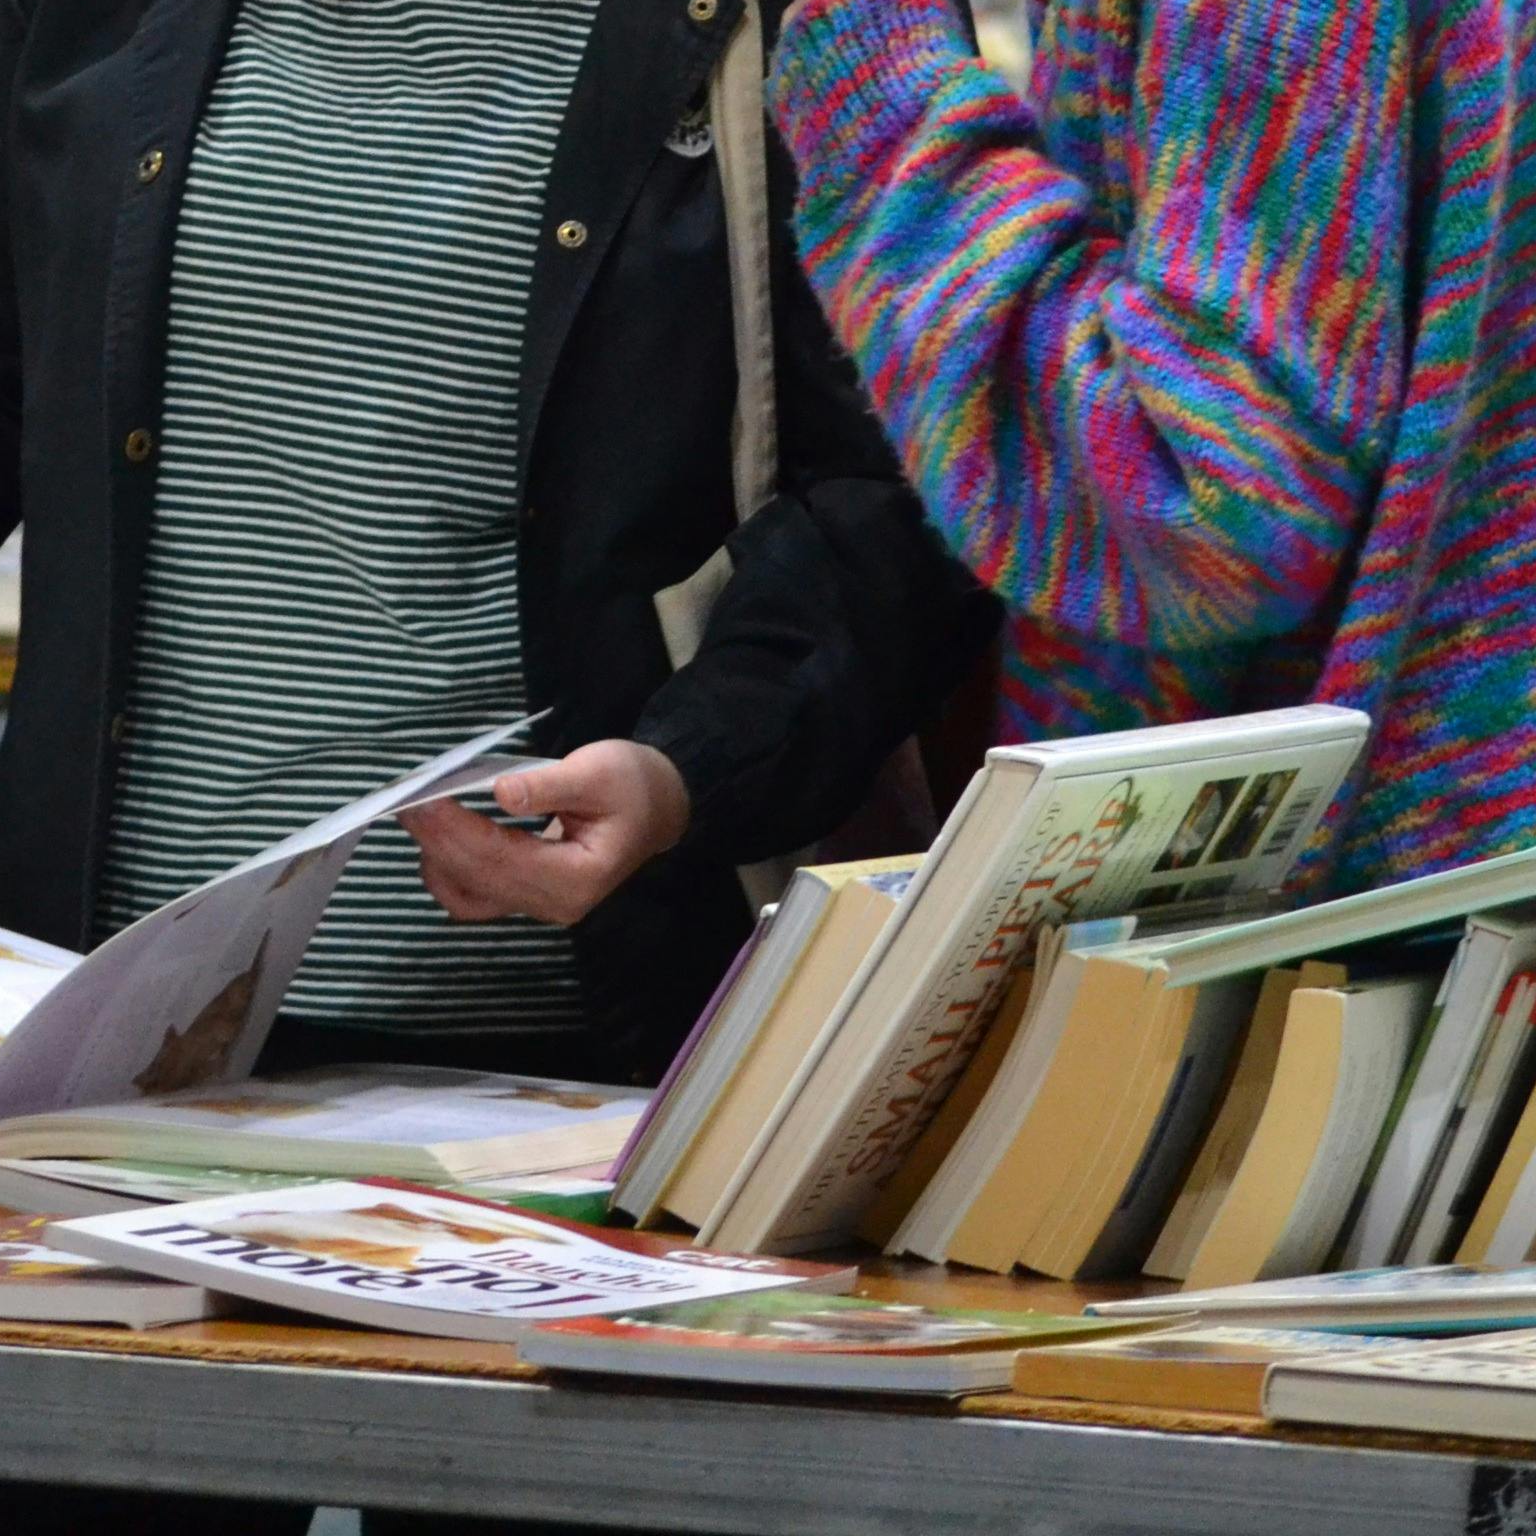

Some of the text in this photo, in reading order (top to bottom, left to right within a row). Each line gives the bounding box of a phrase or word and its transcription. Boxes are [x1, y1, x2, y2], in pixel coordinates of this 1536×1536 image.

[911, 842, 1043, 1031] ENCYCLOPEDIA
[1038, 801, 1063, 836] OF
[840, 831, 1082, 1178] SMALL PETS
[404, 1261, 560, 1294] no
[469, 1248, 697, 1293] naughty
